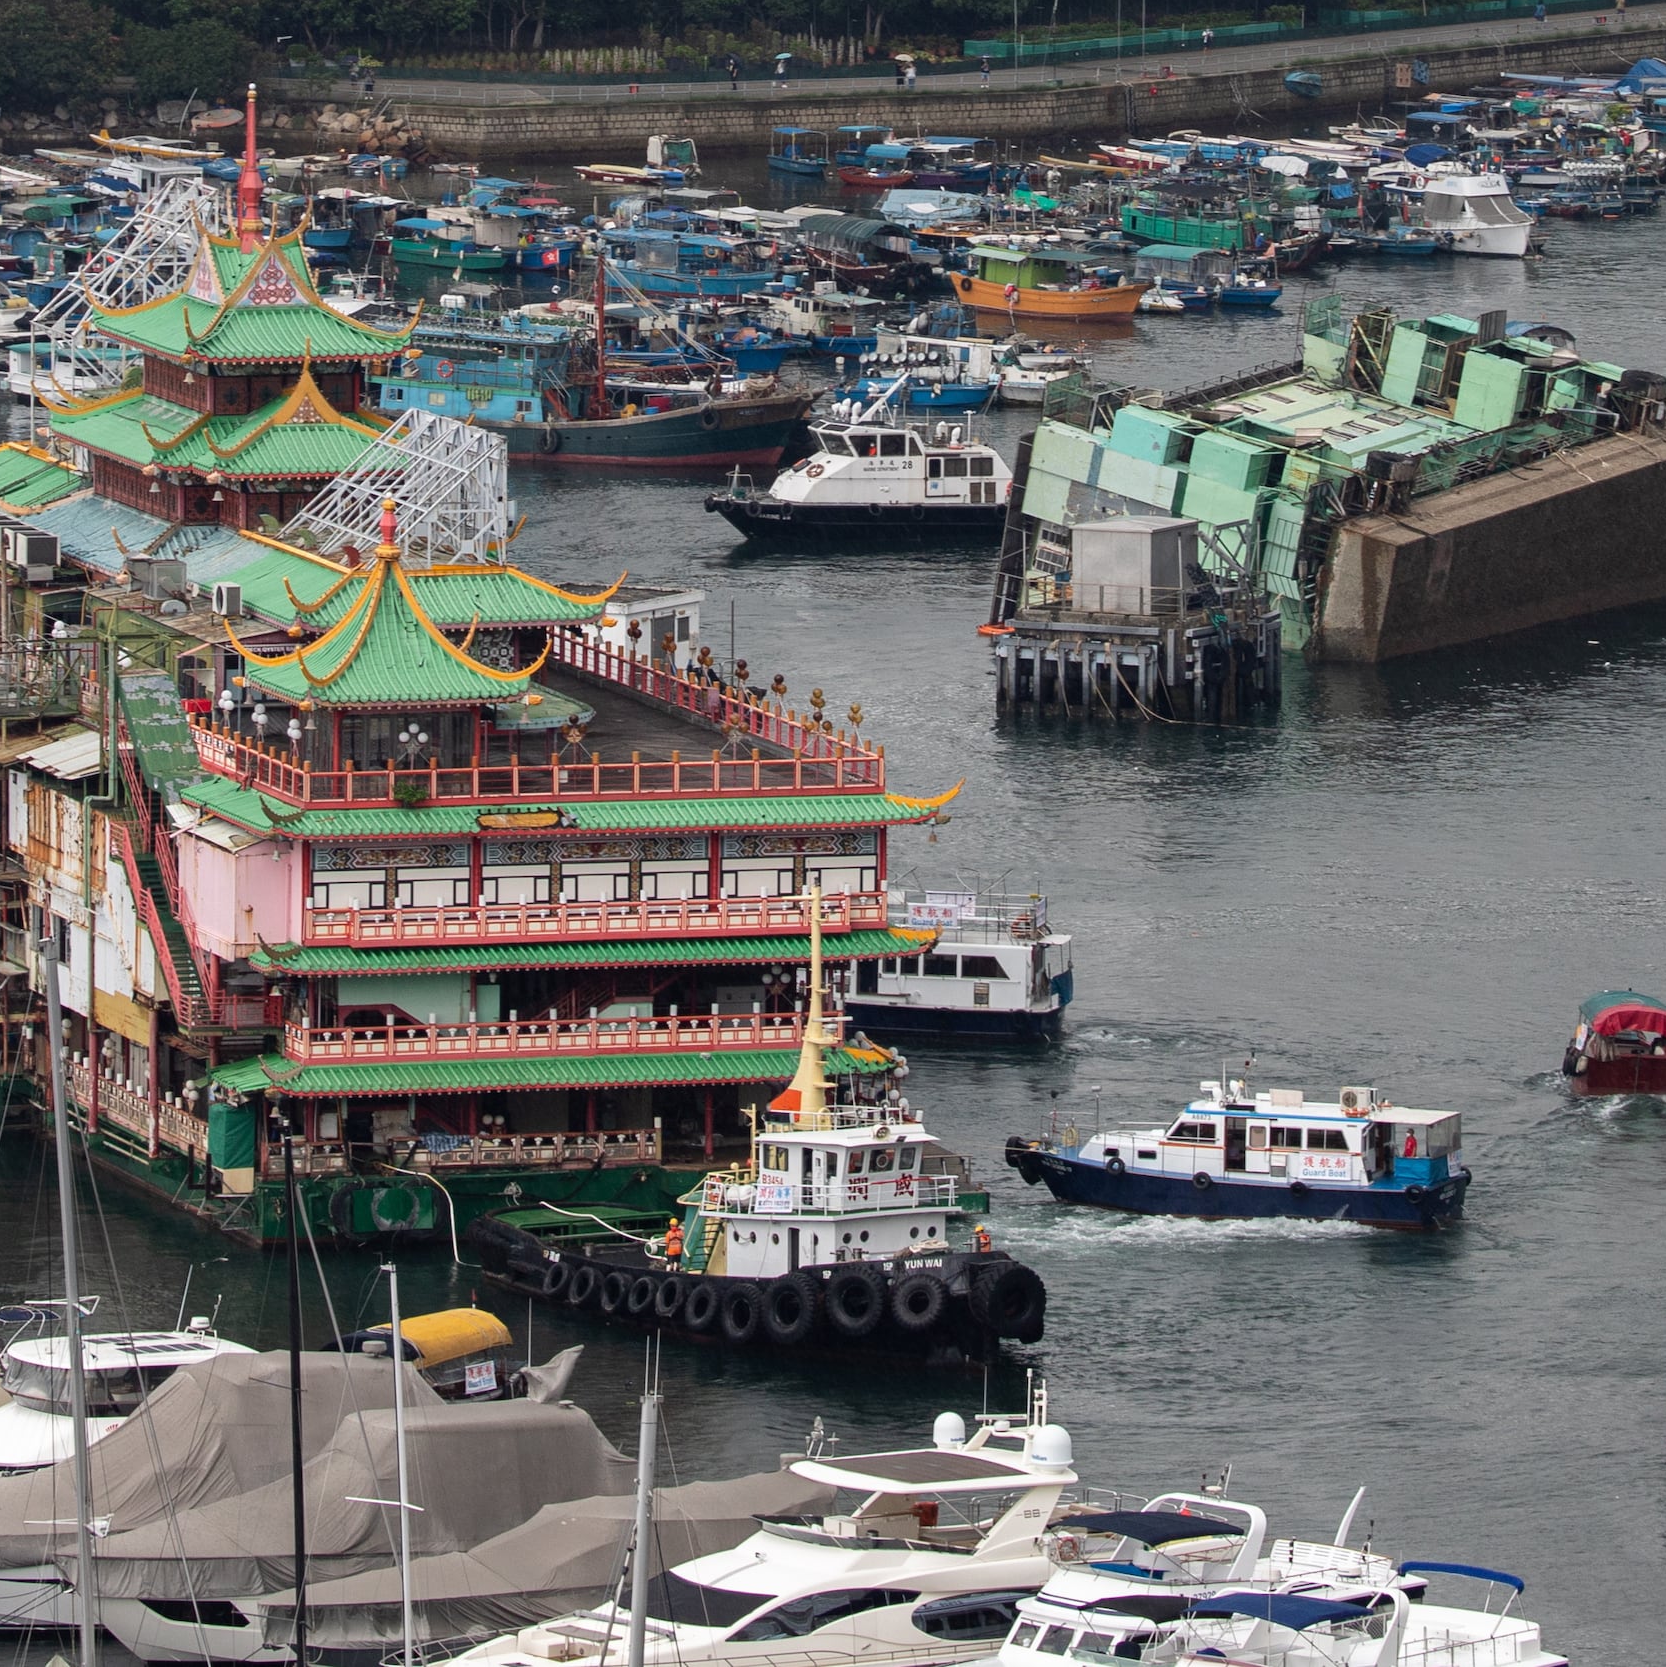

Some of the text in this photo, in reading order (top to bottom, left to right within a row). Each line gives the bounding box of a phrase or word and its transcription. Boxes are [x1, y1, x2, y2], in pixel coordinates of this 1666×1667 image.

[902, 460, 913, 470] 28
[912, 906, 953, 917] 護航船
[911, 917, 934, 926] Guard
[1302, 1156, 1346, 1168] 護航船
[1302, 1168, 1346, 1178] Guard Boat
[847, 1173, 914, 1201] 潤威
[904, 1259, 924, 1270] YUN
[924, 1258, 943, 1268] WAI
